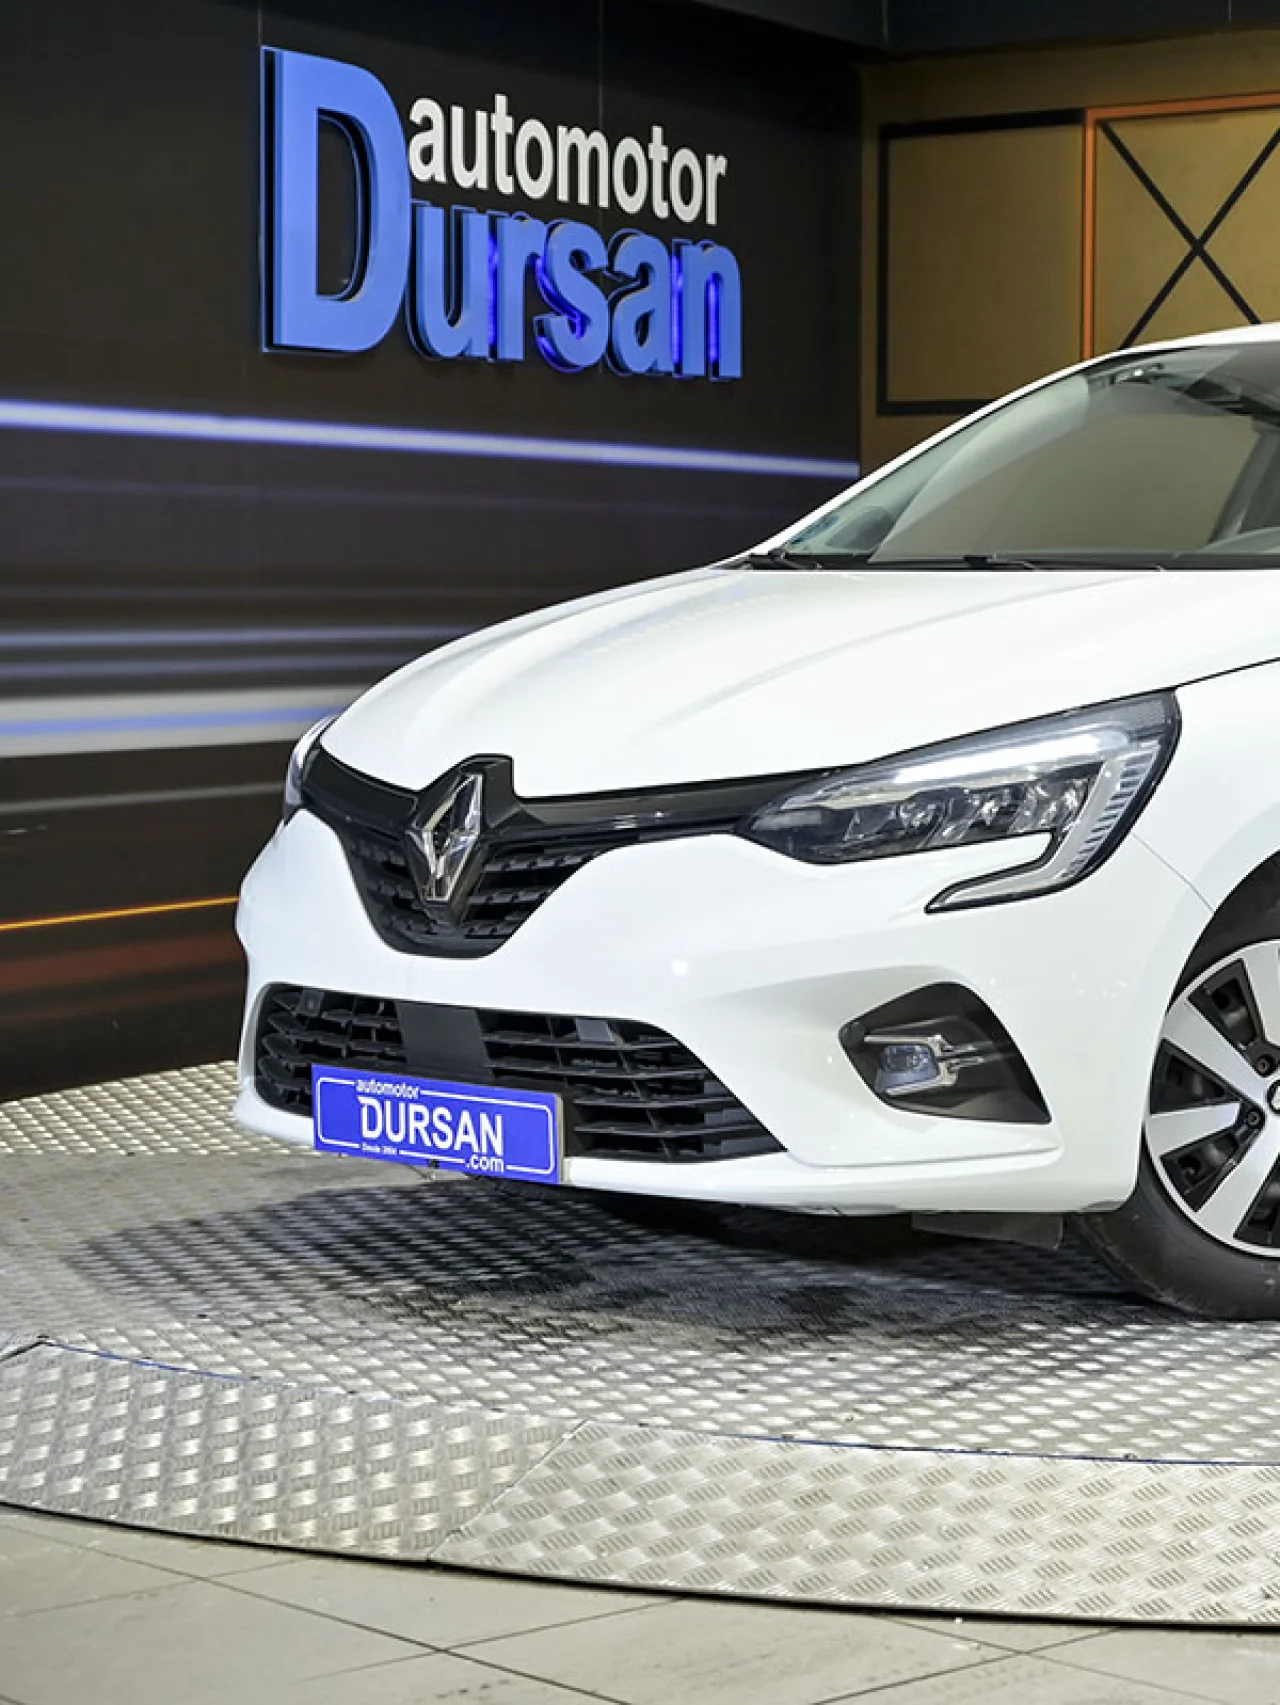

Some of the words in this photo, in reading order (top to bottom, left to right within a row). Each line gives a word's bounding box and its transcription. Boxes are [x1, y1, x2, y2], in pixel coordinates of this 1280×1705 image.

[408, 94, 727, 225] automotor
[262, 46, 742, 379] Dursan
[356, 1079, 419, 1099] automotor
[358, 1097, 504, 1156] DURSAN
[466, 1155, 504, 1173] .com
